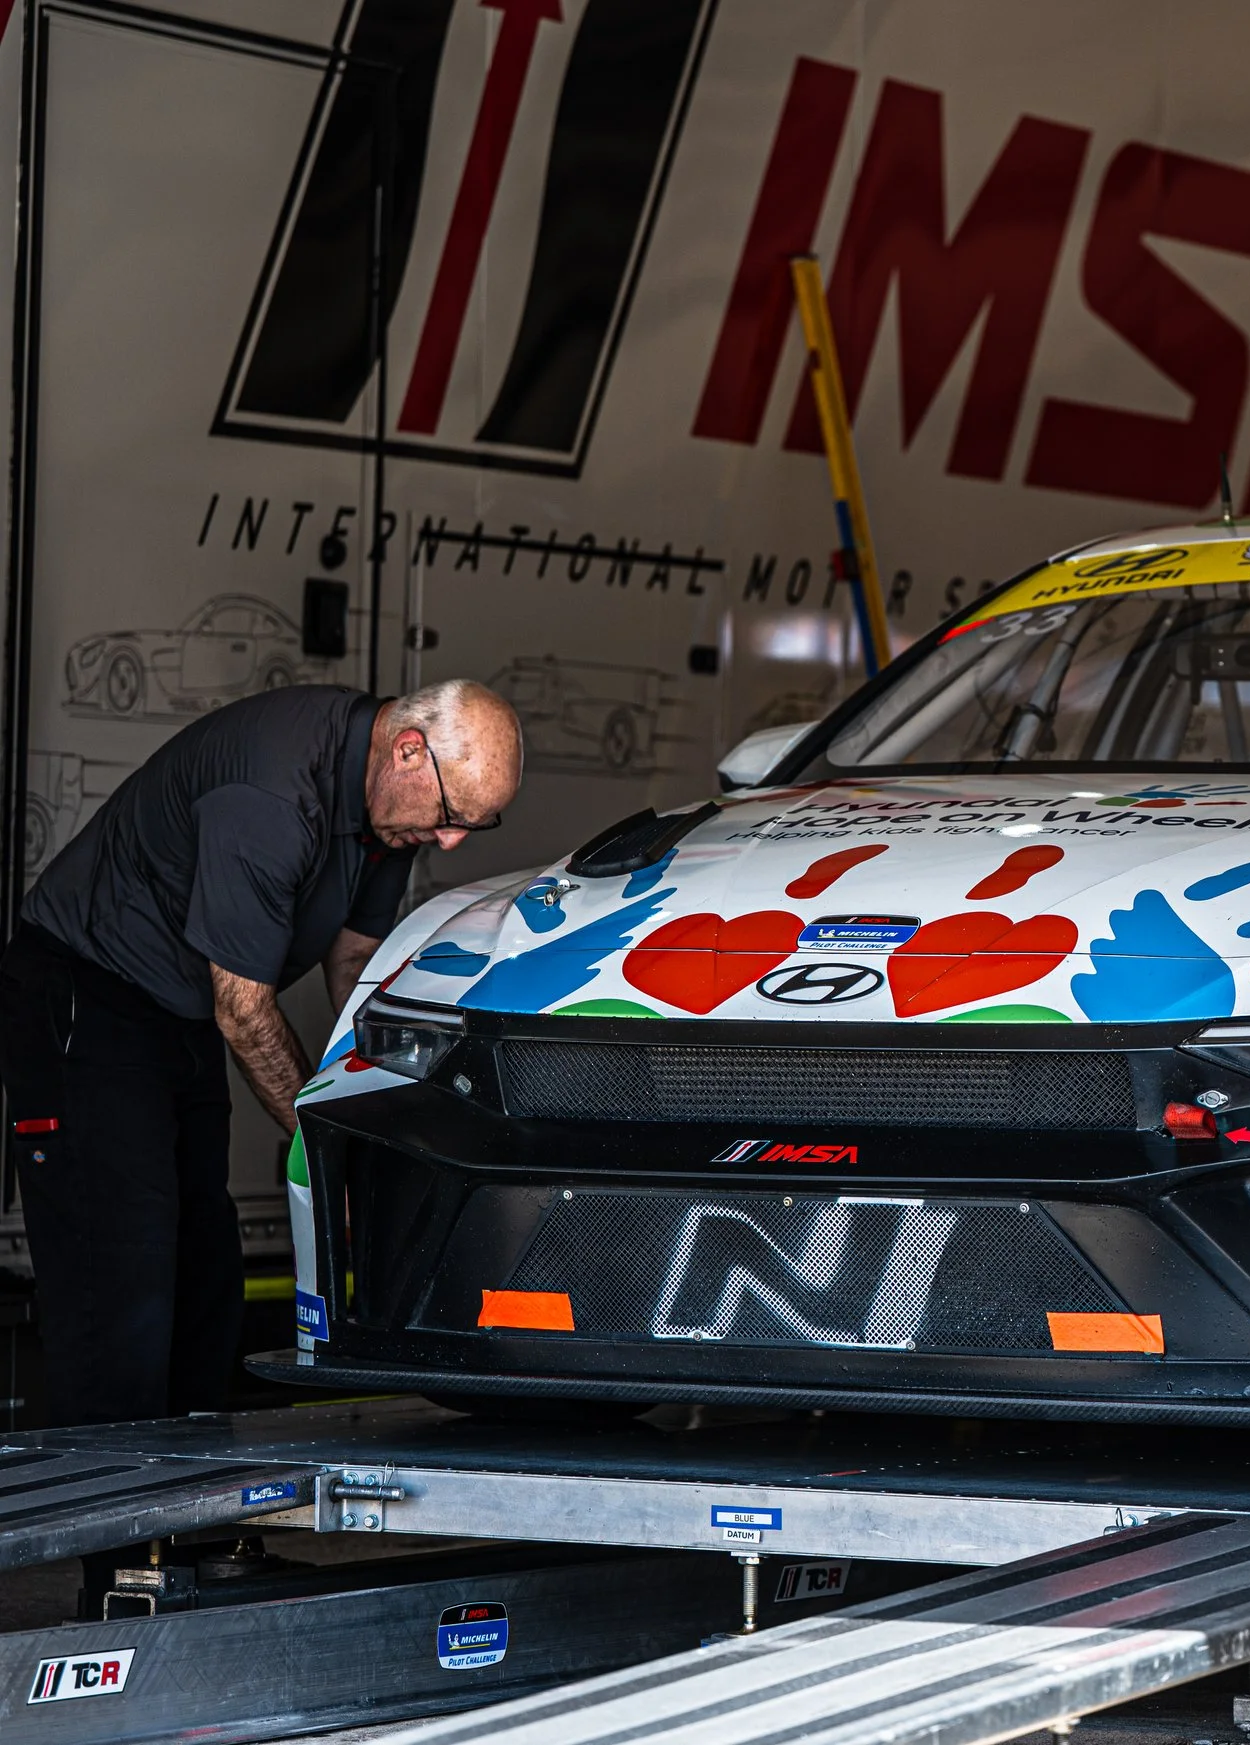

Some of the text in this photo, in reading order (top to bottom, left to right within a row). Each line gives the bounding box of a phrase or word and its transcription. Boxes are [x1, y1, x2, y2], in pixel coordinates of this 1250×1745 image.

[198, 493, 705, 595] INTERNATIONAL
[1032, 568, 1186, 600] HYUNDAI
[980, 605, 1077, 643] 33
[786, 796, 1076, 815] Hyundai
[751, 811, 931, 829] Hope
[940, 811, 1026, 824] on
[726, 824, 1137, 841] Helping kids figh ancer
[757, 1143, 859, 1164] IMSA
[296, 1303, 320, 1325] ELIN
[734, 1514, 754, 1523] BLUE
[727, 1530, 754, 1540] DATUM
[806, 1566, 842, 1592] TCR
[461, 1632, 498, 1644] MICHELIN
[448, 1654, 497, 1667] PILOT CHALLENGE
[72, 1660, 120, 1689] TCR
